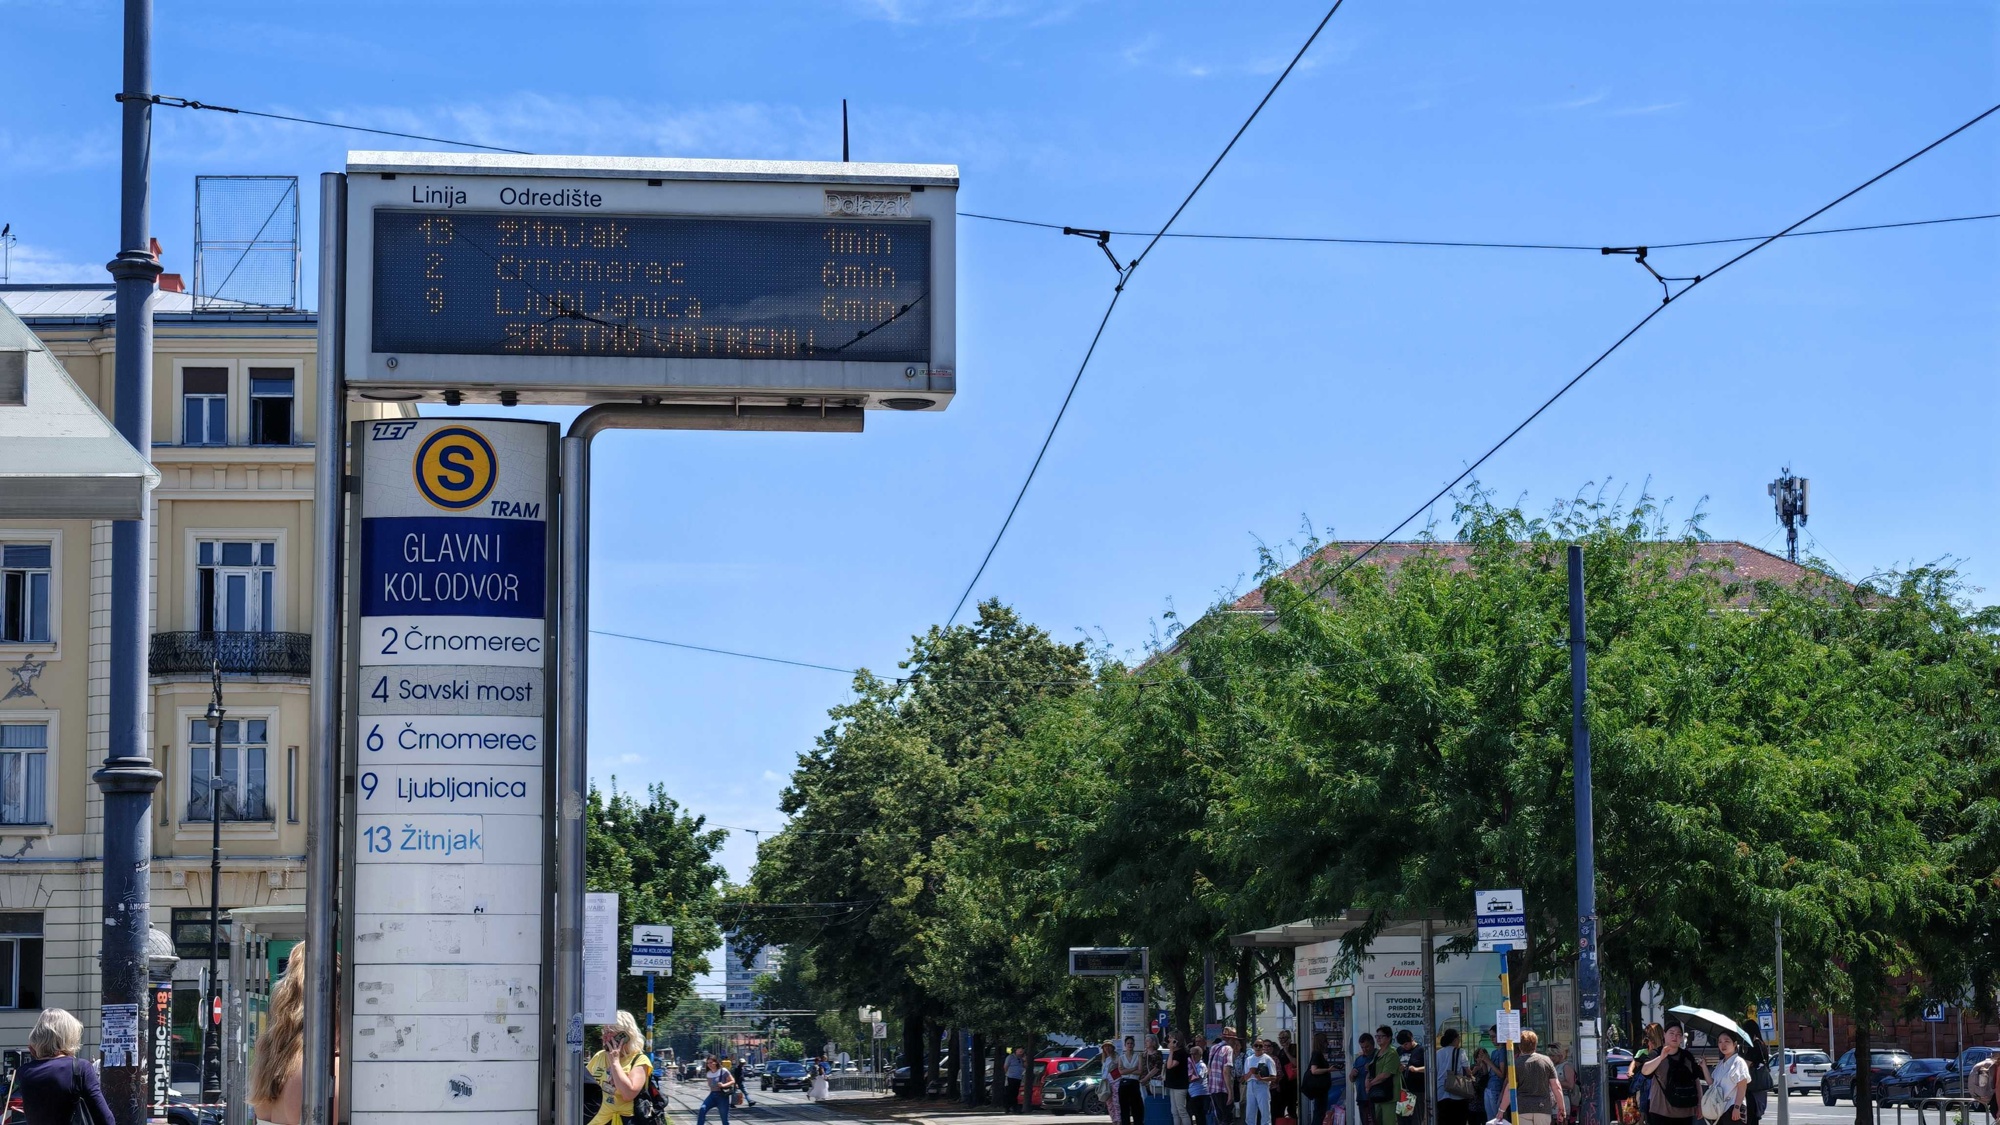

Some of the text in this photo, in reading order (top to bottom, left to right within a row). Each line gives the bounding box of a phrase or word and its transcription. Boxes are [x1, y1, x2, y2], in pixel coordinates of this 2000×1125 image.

[412, 185, 602, 208] Linija Odredište
[826, 194, 911, 215] Dolazak
[418, 219, 453, 244] 13
[823, 228, 891, 254] 1min
[426, 253, 443, 278] 2
[823, 262, 895, 288] 6min
[426, 287, 443, 313] 9
[823, 296, 895, 322] 6min
[505, 323, 640, 351] SRETNO
[373, 421, 418, 441] ZET
[437, 445, 475, 491] S
[490, 500, 541, 519] TRAM
[404, 533, 500, 563] GLAVNI
[384, 572, 519, 602] KOLODVOR
[381, 626, 541, 655] 2 Črnomerec
[371, 676, 533, 703] 4 Savski most
[366, 722, 537, 752] 6 Črnomerec
[361, 772, 527, 802] 9 Ljubljanica
[363, 824, 482, 856] 13 Žitnjak
[1384, 967, 1422, 978] Jamnic
[1159, 1013, 1166, 1024] P
